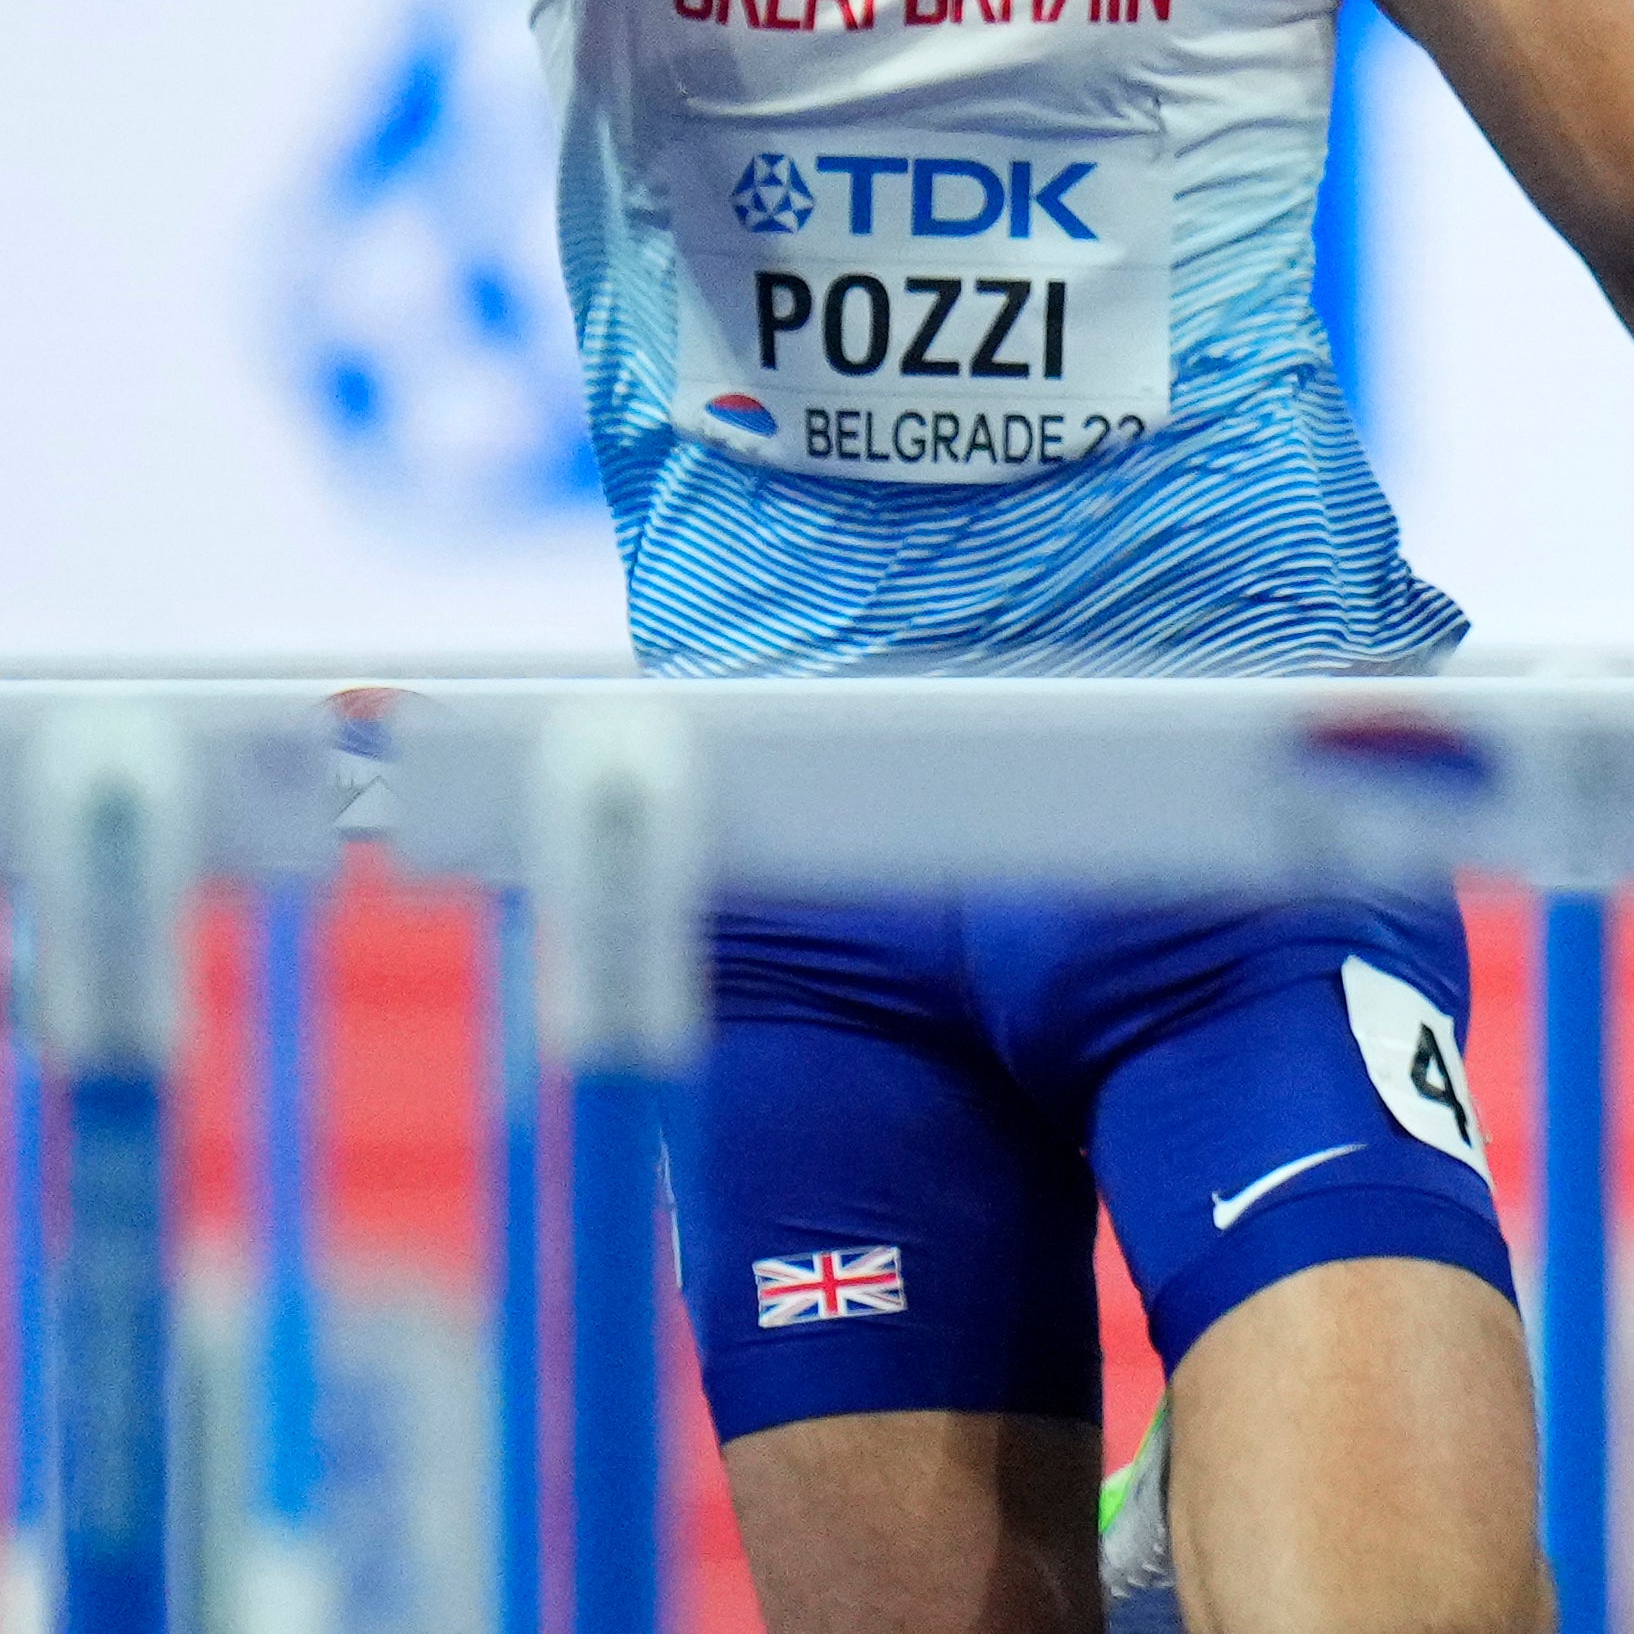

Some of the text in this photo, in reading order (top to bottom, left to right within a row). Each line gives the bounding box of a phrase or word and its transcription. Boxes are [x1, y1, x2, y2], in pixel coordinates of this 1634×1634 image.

[816, 155, 1099, 242] TDK
[754, 270, 1067, 381] POZZI
[803, 408, 1066, 466] BELGRADE
[1410, 1022, 1473, 1149] 4
